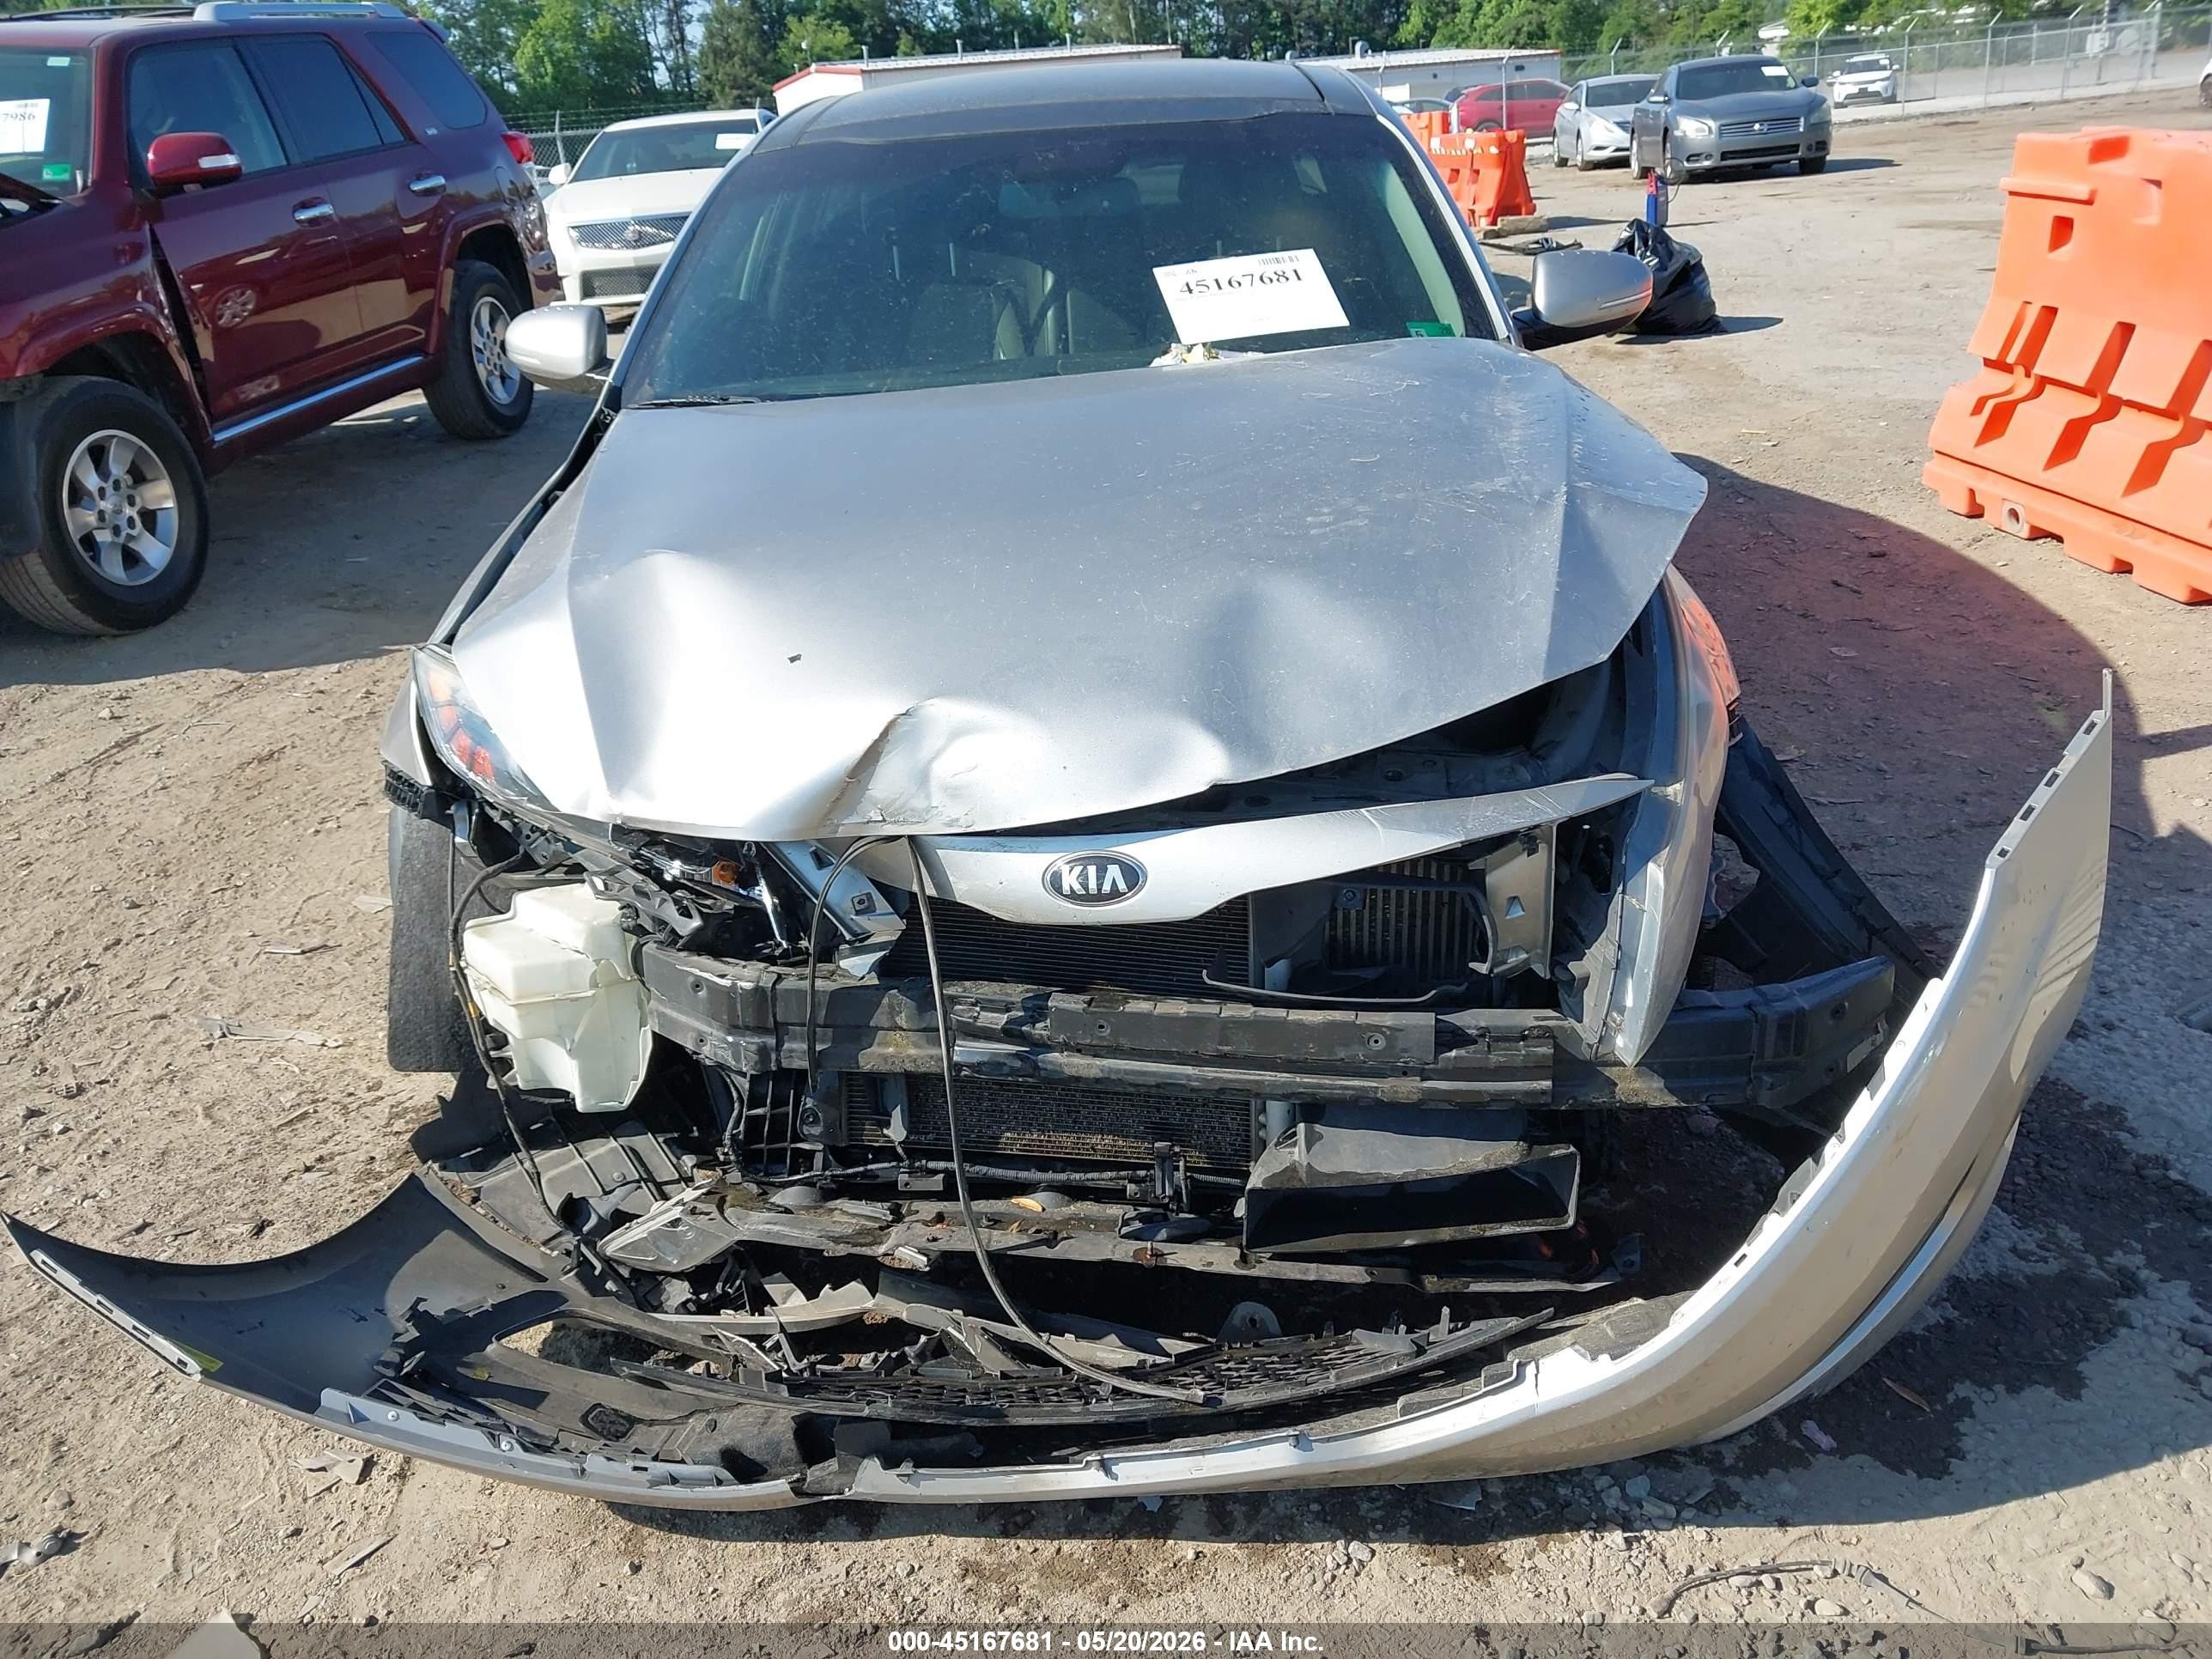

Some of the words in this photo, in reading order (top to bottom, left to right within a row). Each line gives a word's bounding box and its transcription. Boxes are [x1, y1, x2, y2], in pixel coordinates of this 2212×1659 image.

[2, 111, 36, 123] 7986
[1179, 268, 1303, 295] 45167681
[1060, 864, 1128, 895] KIA
